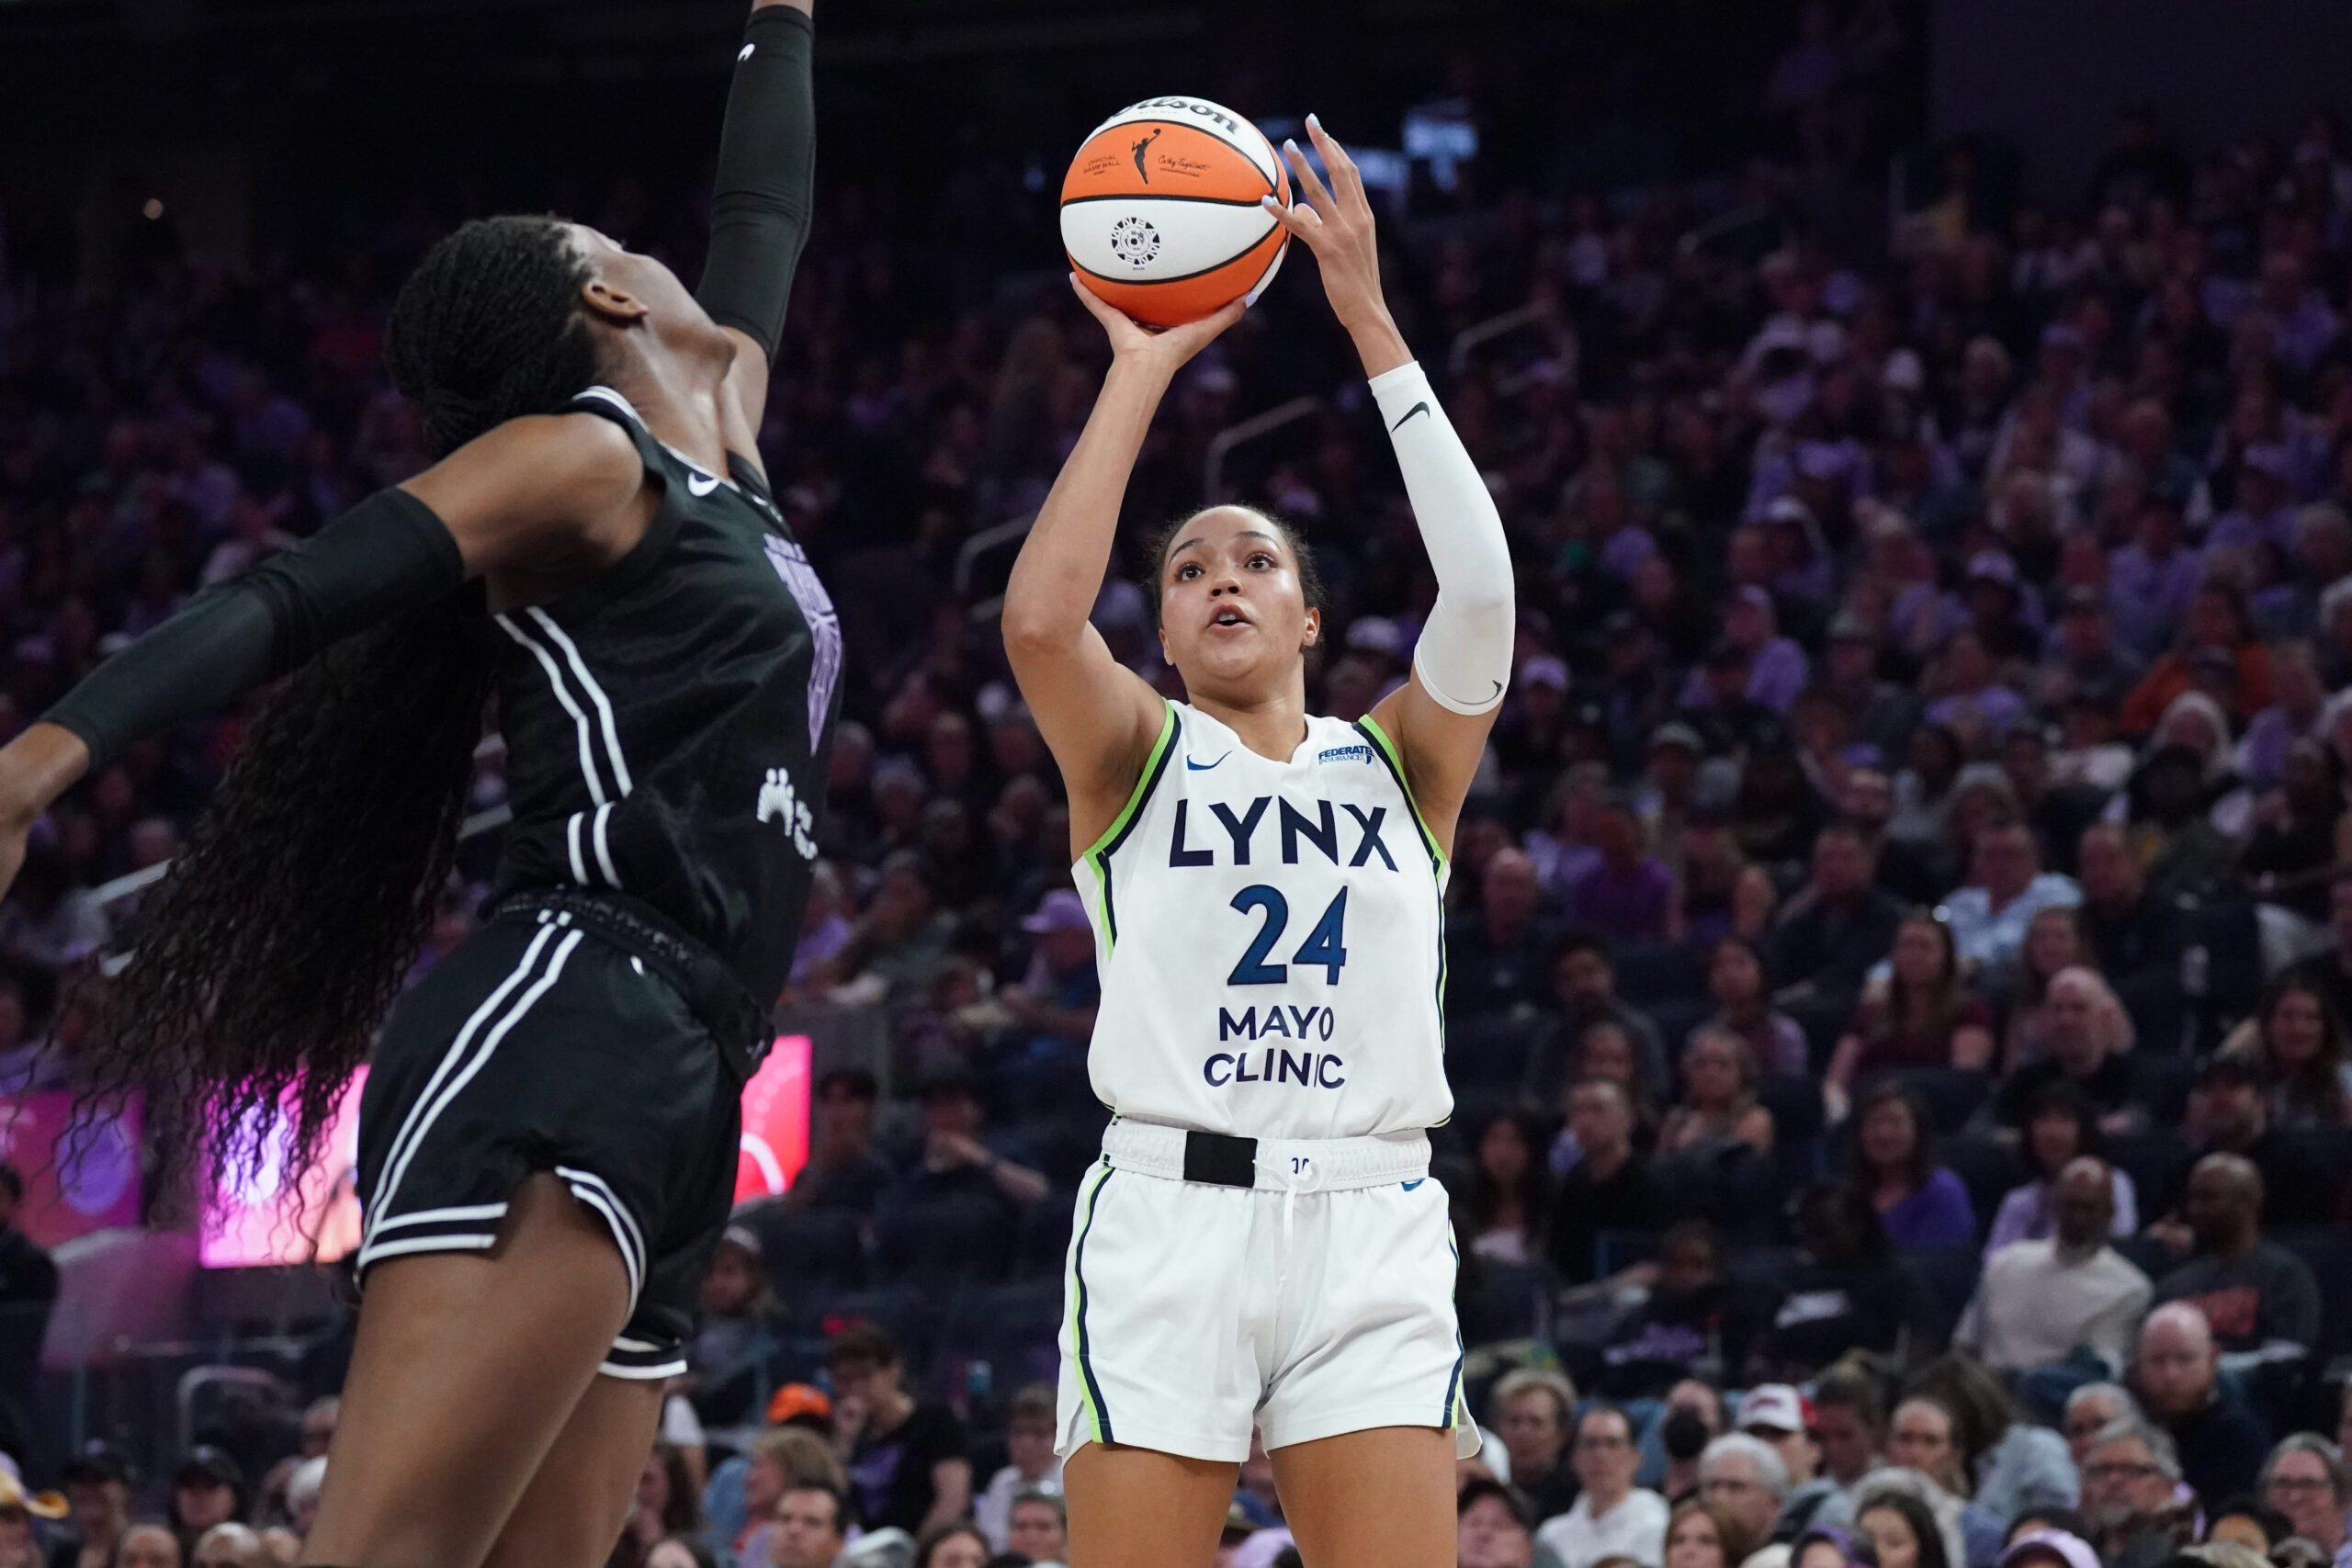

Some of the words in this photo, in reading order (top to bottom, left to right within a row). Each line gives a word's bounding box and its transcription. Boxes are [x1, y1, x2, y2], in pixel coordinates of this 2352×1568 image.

[1112, 96, 1238, 135] ilson
[1170, 795, 1399, 873] LYNX
[1227, 884, 1348, 986] 24
[1219, 1005, 1334, 1042] MAYO
[1204, 1048, 1346, 1089] CLINIC
